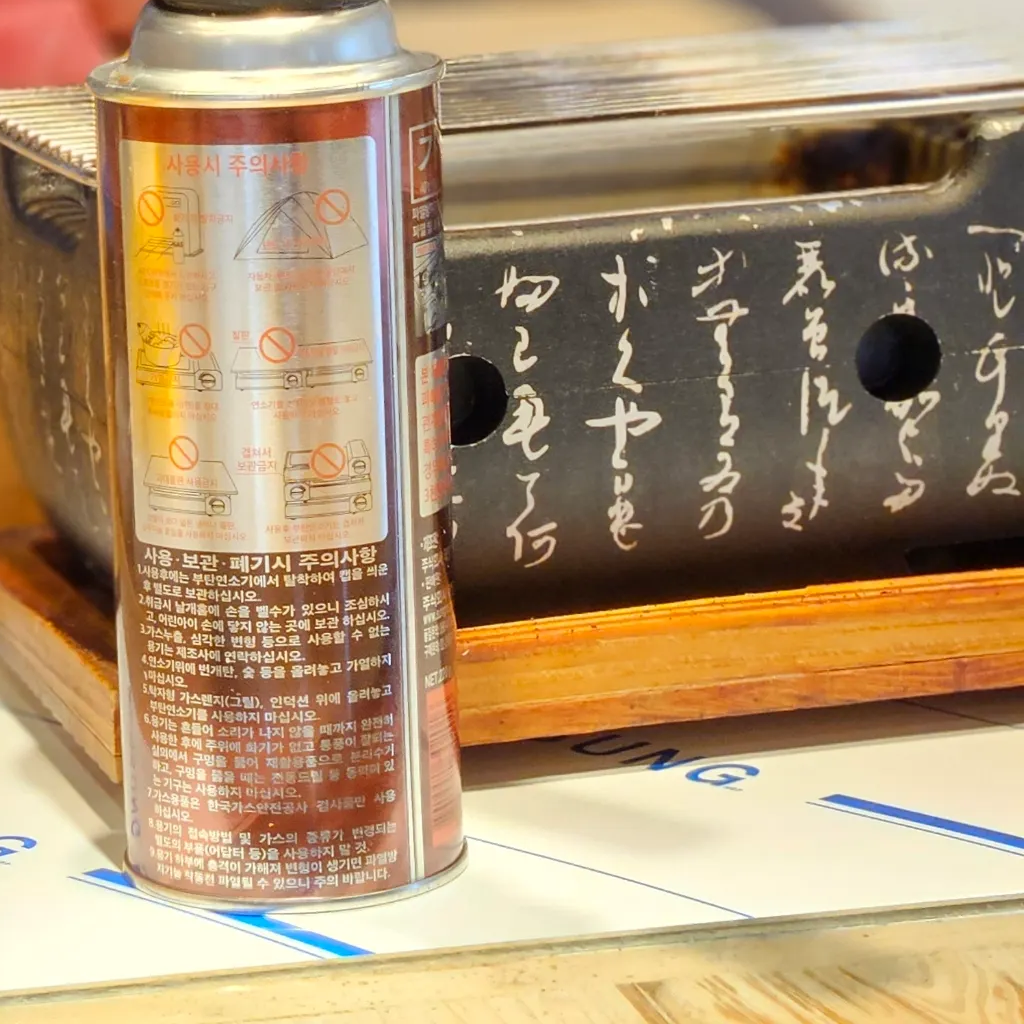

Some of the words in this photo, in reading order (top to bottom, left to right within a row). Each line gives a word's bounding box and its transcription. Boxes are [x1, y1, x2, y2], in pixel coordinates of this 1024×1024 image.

[167, 153, 221, 177] 사용시
[241, 446, 272, 459] 겹쳐서
[237, 460, 277, 472] 보관금지
[299, 545, 377, 571] 주의사항
[193, 574, 279, 588] 부탄연소기에서
[283, 572, 334, 587] 탈착하여
[153, 582, 182, 597] 별도로
[185, 587, 262, 603] 보관하십시오.
[138, 594, 172, 611] 2.취급시
[225, 606, 250, 617] 손을
[301, 601, 339, 616] 있으니
[344, 592, 390, 611] 조심하시
[158, 614, 197, 630] 어린아이
[201, 620, 224, 632] 손에
[228, 621, 252, 633] 닿지
[256, 620, 282, 634] 않는
[285, 619, 310, 632] 곳에
[315, 617, 339, 630] 보관
[343, 609, 390, 627] 하십시오.
[191, 633, 225, 647] 심각한
[231, 636, 256, 648] 변형
[262, 635, 301, 648] 등으로
[307, 631, 345, 646] 사용할
[352, 629, 363, 641] 수
[368, 625, 390, 639] 없는
[147, 640, 173, 657] 용기는
[176, 646, 221, 662] 제조사에
[225, 650, 306, 663] 연락하십시오.
[141, 654, 196, 674] 4.연소기위에
[198, 664, 237, 679] 번개탄,
[242, 666, 255, 679] 숯
[260, 666, 285, 679] 등을
[291, 663, 342, 678] 올려놓고
[347, 653, 392, 672] 가열하지
[270, 695, 309, 708] 인덕션
[316, 692, 341, 706] 위에
[347, 684, 392, 703] 올려놓고
[150, 700, 208, 721] 부탄연소기를
[212, 711, 260, 723] 사용하지
[264, 710, 321, 723] 마십시오.
[144, 713, 177, 732] 6.용기는
[181, 722, 213, 737] 흔들어
[218, 727, 254, 739] 소리가
[259, 727, 284, 739] 나지
[289, 726, 315, 738] 않을
[320, 720, 356, 736] 때까지
[361, 714, 393, 730] 완전히
[151, 730, 177, 746] 사용한
[181, 737, 202, 750] 후에
[206, 739, 241, 753] 주위에
[152, 745, 188, 763] 실외에서
[192, 753, 227, 768] 구멍을
[350, 744, 394, 763] 분리수거
[536, 734, 761, 787] UNG
[175, 765, 207, 781] 구멍을
[164, 777, 192, 793] 기구는
[196, 783, 241, 798] 사용하지
[207, 799, 308, 814] 한국가스안전공사
[375, 789, 396, 804] 사용
[155, 834, 181, 850] 별도의
[284, 845, 334, 860] 사용하지
[188, 827, 232, 844] 접속방법
[239, 833, 251, 845] 및
[260, 832, 298, 846] 가스의
[175, 854, 204, 871] 하부에
[208, 860, 241, 874] 충격이
[286, 861, 322, 874] 변형이
[327, 856, 362, 873] 생기면
[257, 878, 269, 890] 수
[273, 877, 310, 890] 있으니
[314, 875, 338, 888] 주의
[342, 868, 391, 885] 바랍니다.
